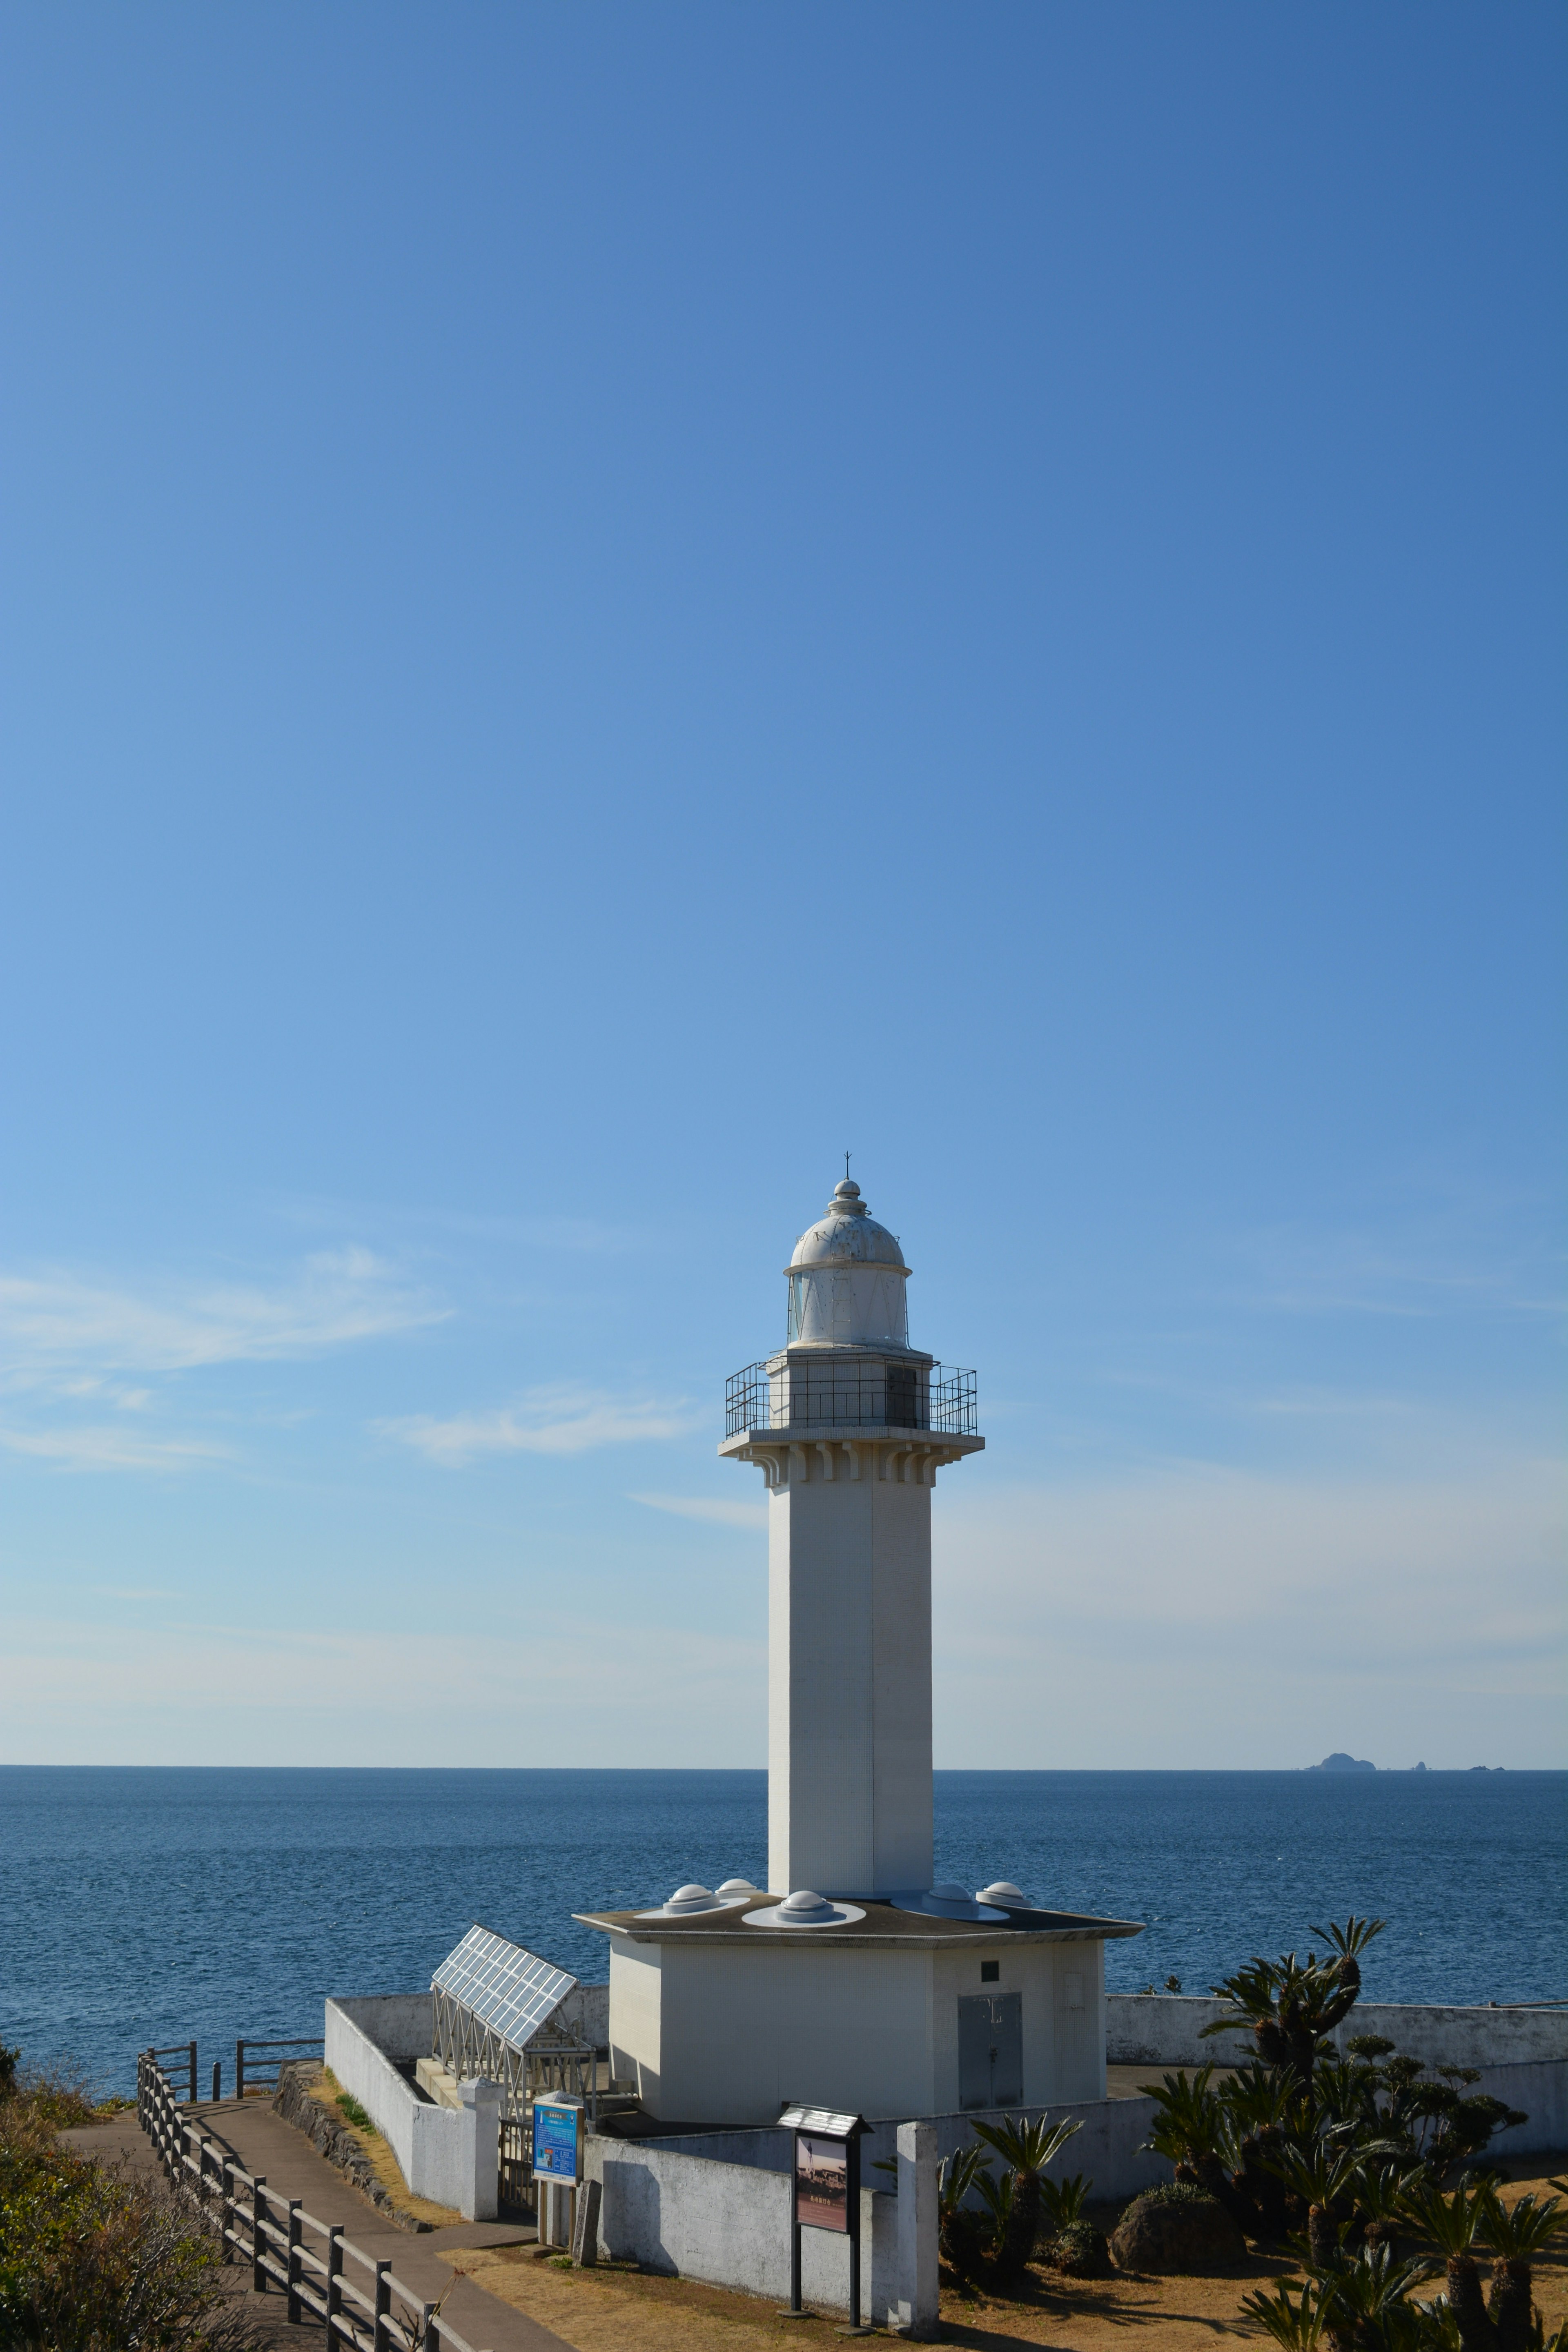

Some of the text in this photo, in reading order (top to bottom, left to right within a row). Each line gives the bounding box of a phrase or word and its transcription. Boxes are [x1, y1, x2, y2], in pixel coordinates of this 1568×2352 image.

[810, 2196, 831, 2205] 長崎鼻灯台
